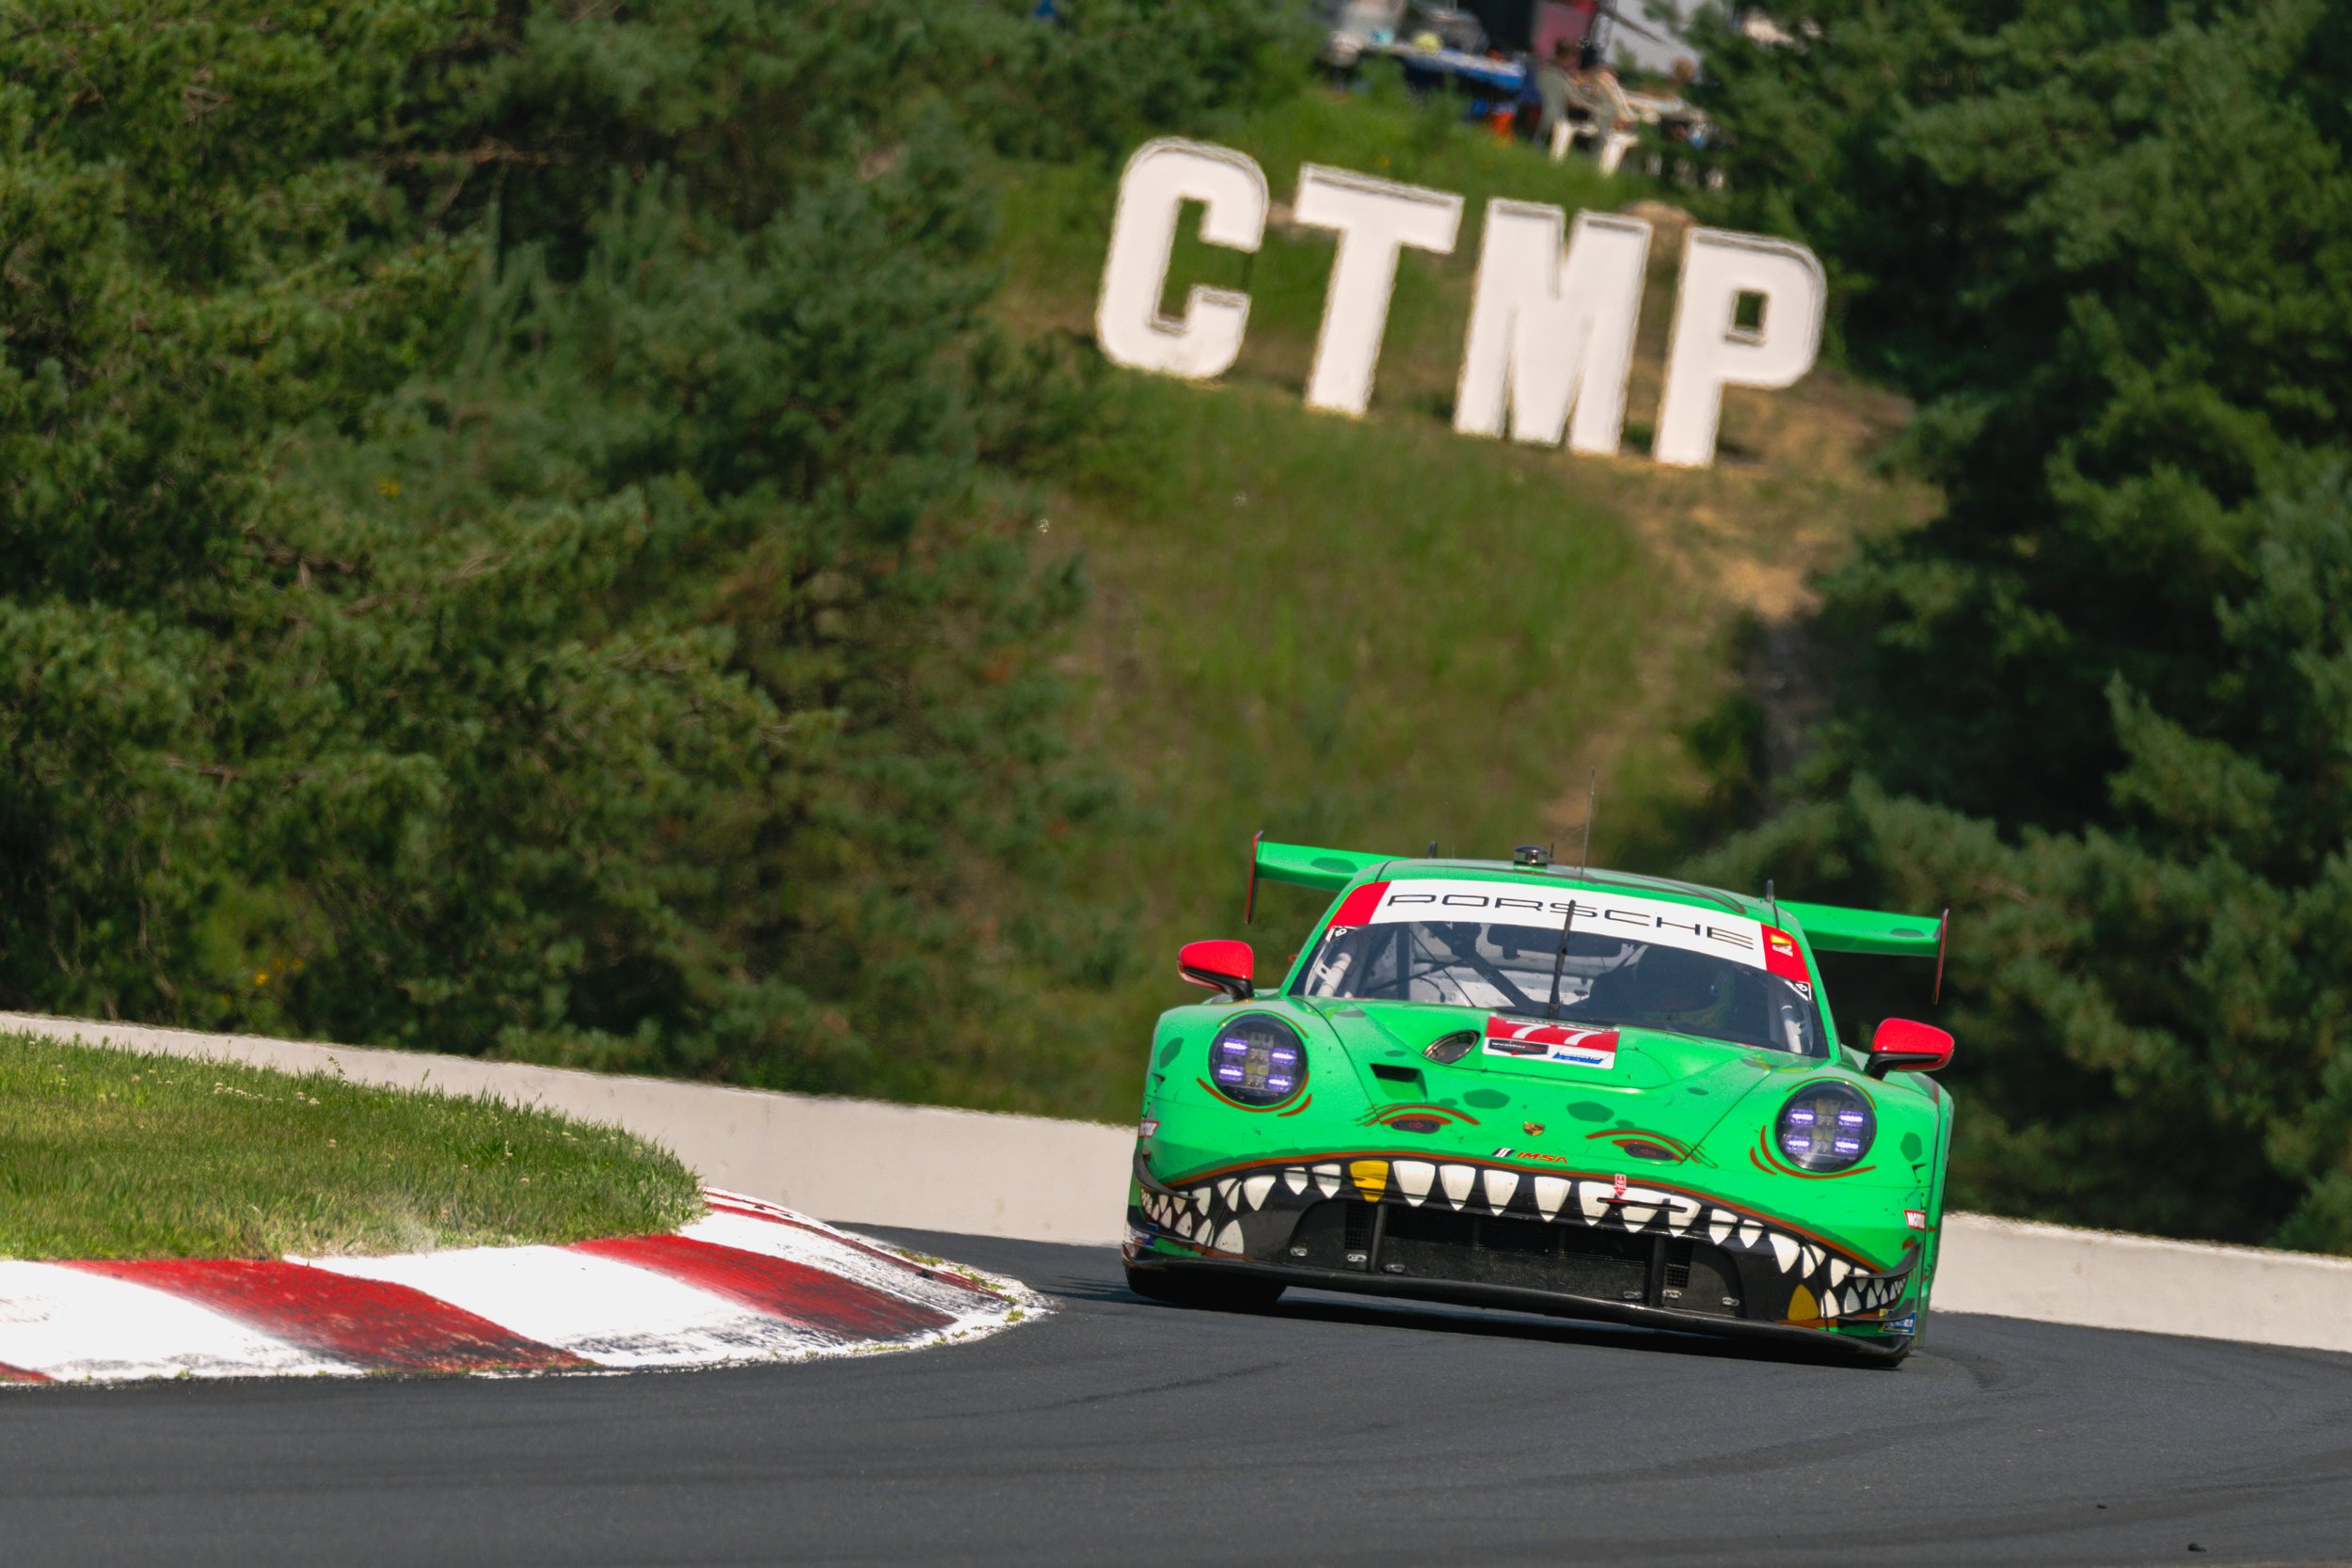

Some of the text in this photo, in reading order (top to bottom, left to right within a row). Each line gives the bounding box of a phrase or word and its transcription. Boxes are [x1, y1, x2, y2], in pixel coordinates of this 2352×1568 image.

[1094, 135, 1828, 467] CTMP
[1387, 894, 1755, 951] PORSCHE
[1506, 1020, 1603, 1047] 77
[1516, 1150, 1567, 1164] IMSA
